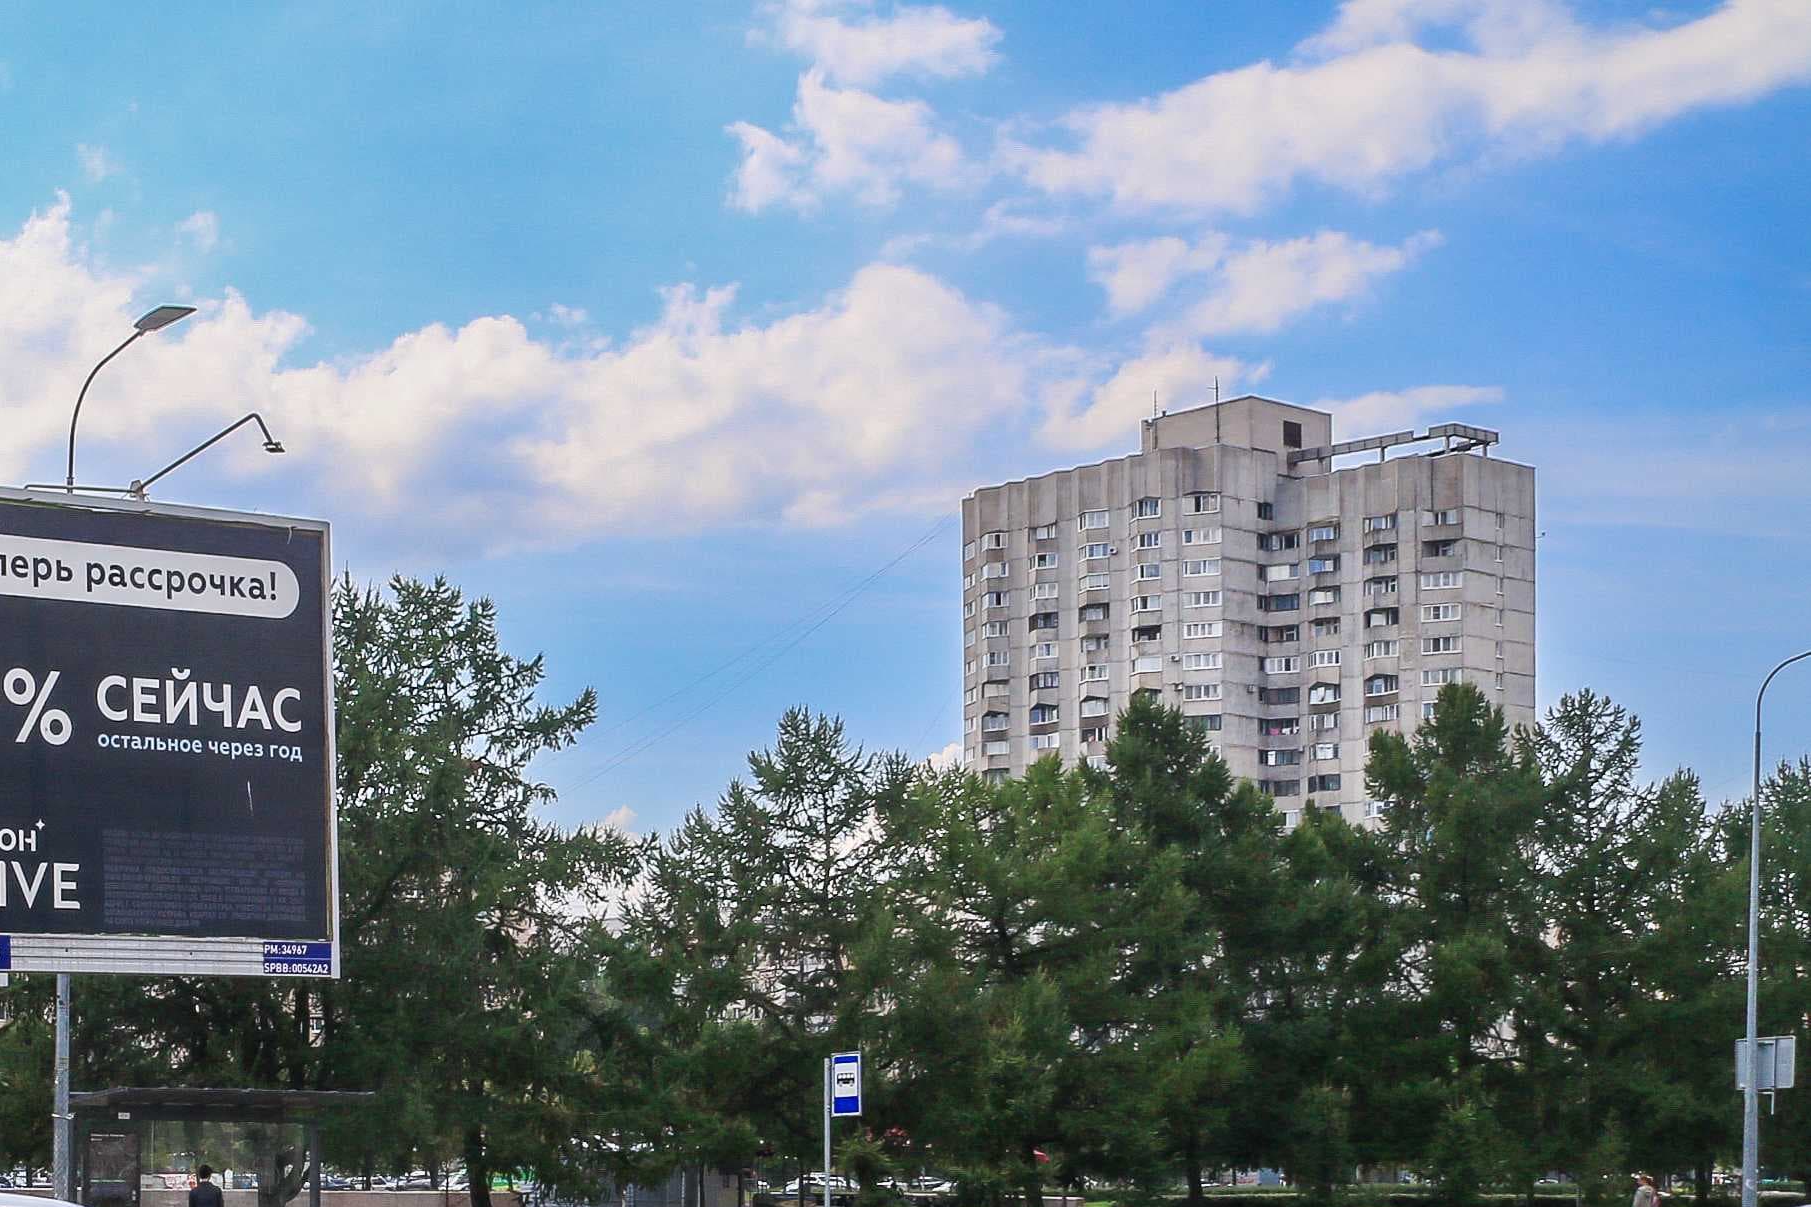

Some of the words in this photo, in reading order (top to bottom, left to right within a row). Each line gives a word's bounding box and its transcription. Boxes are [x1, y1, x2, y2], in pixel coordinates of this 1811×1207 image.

[86, 559, 278, 601] рассрочка!
[96, 667, 302, 733] СЕЙЧАС
[97, 732, 203, 755] остальное
[207, 741, 264, 761] через
[269, 743, 303, 763] год
